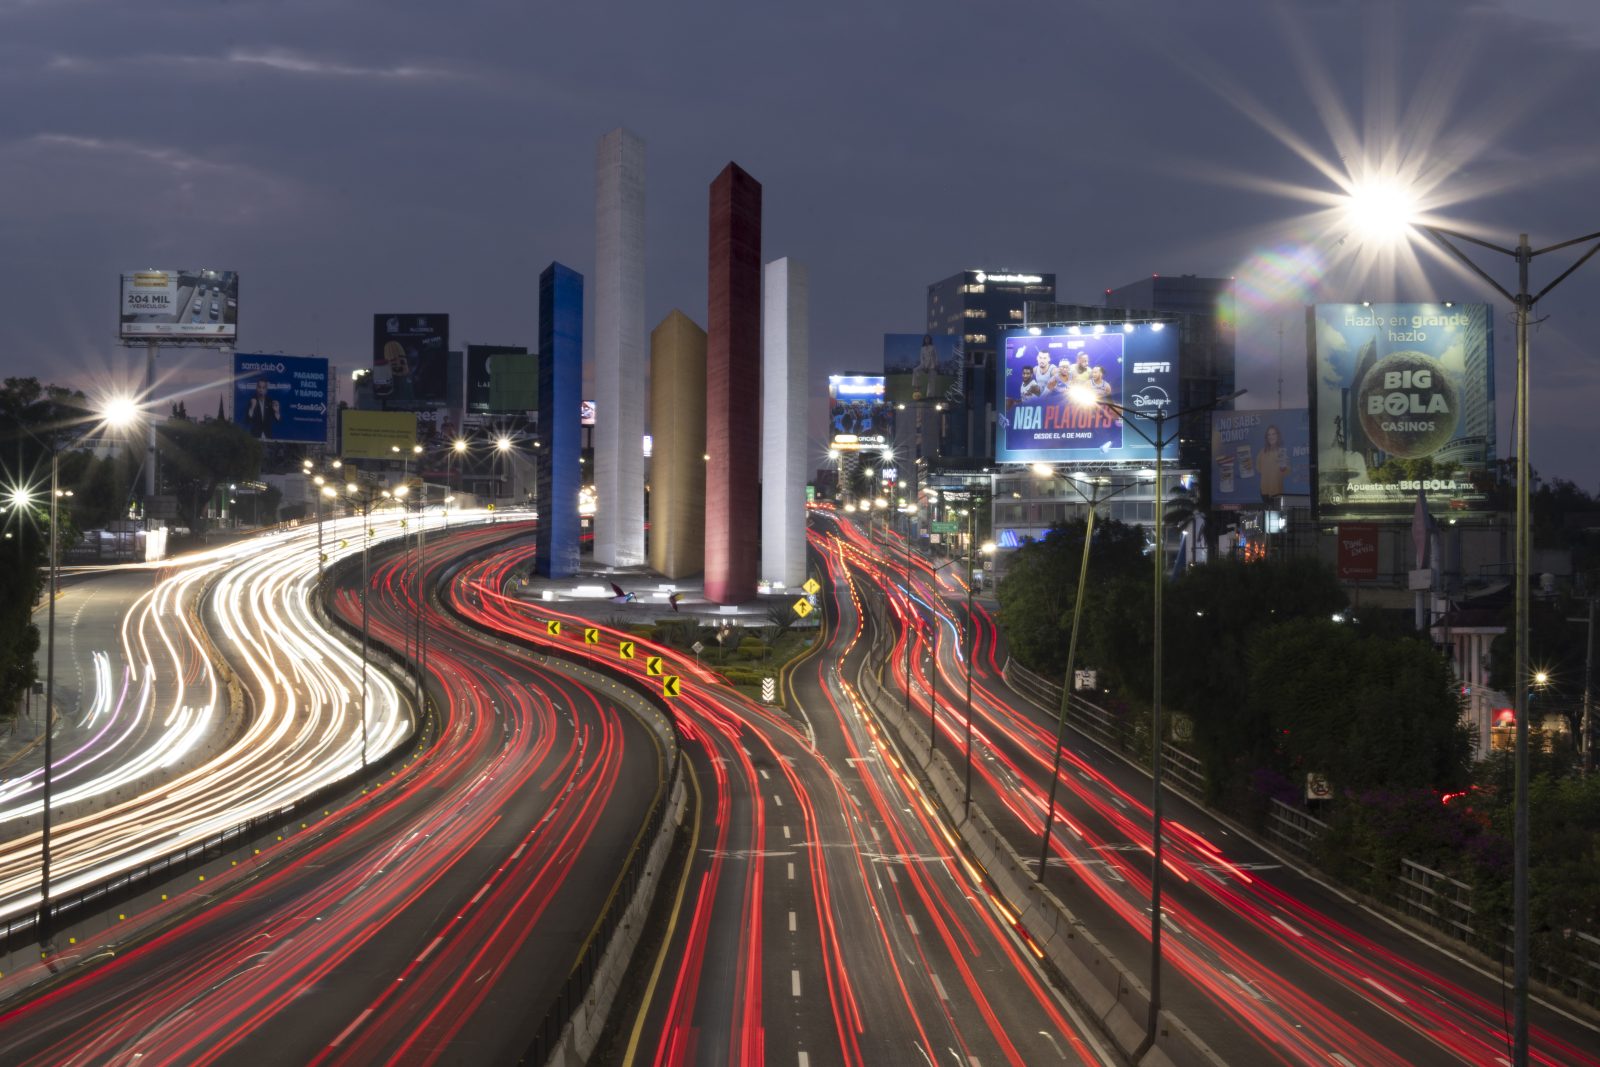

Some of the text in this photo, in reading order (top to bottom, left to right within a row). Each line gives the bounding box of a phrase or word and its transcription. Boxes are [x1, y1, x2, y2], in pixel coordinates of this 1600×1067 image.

[128, 295, 148, 303] 204
[1344, 314, 1469, 329] Hazlo en grande
[1388, 329, 1426, 342] hazlo
[261, 362, 276, 372] club
[1133, 362, 1171, 373] ESPN
[293, 371, 325, 380] PAGANDO
[1383, 370, 1431, 389] BIG
[295, 389, 299, 397] Y
[1367, 392, 1449, 416] BOLA
[1013, 404, 1113, 430] NBA PLAYOFFS
[1381, 421, 1435, 432] CASINOS
[1346, 482, 1383, 492] Apuesta
[1400, 480, 1421, 490] BIG
[1423, 479, 1457, 490] BOLA
